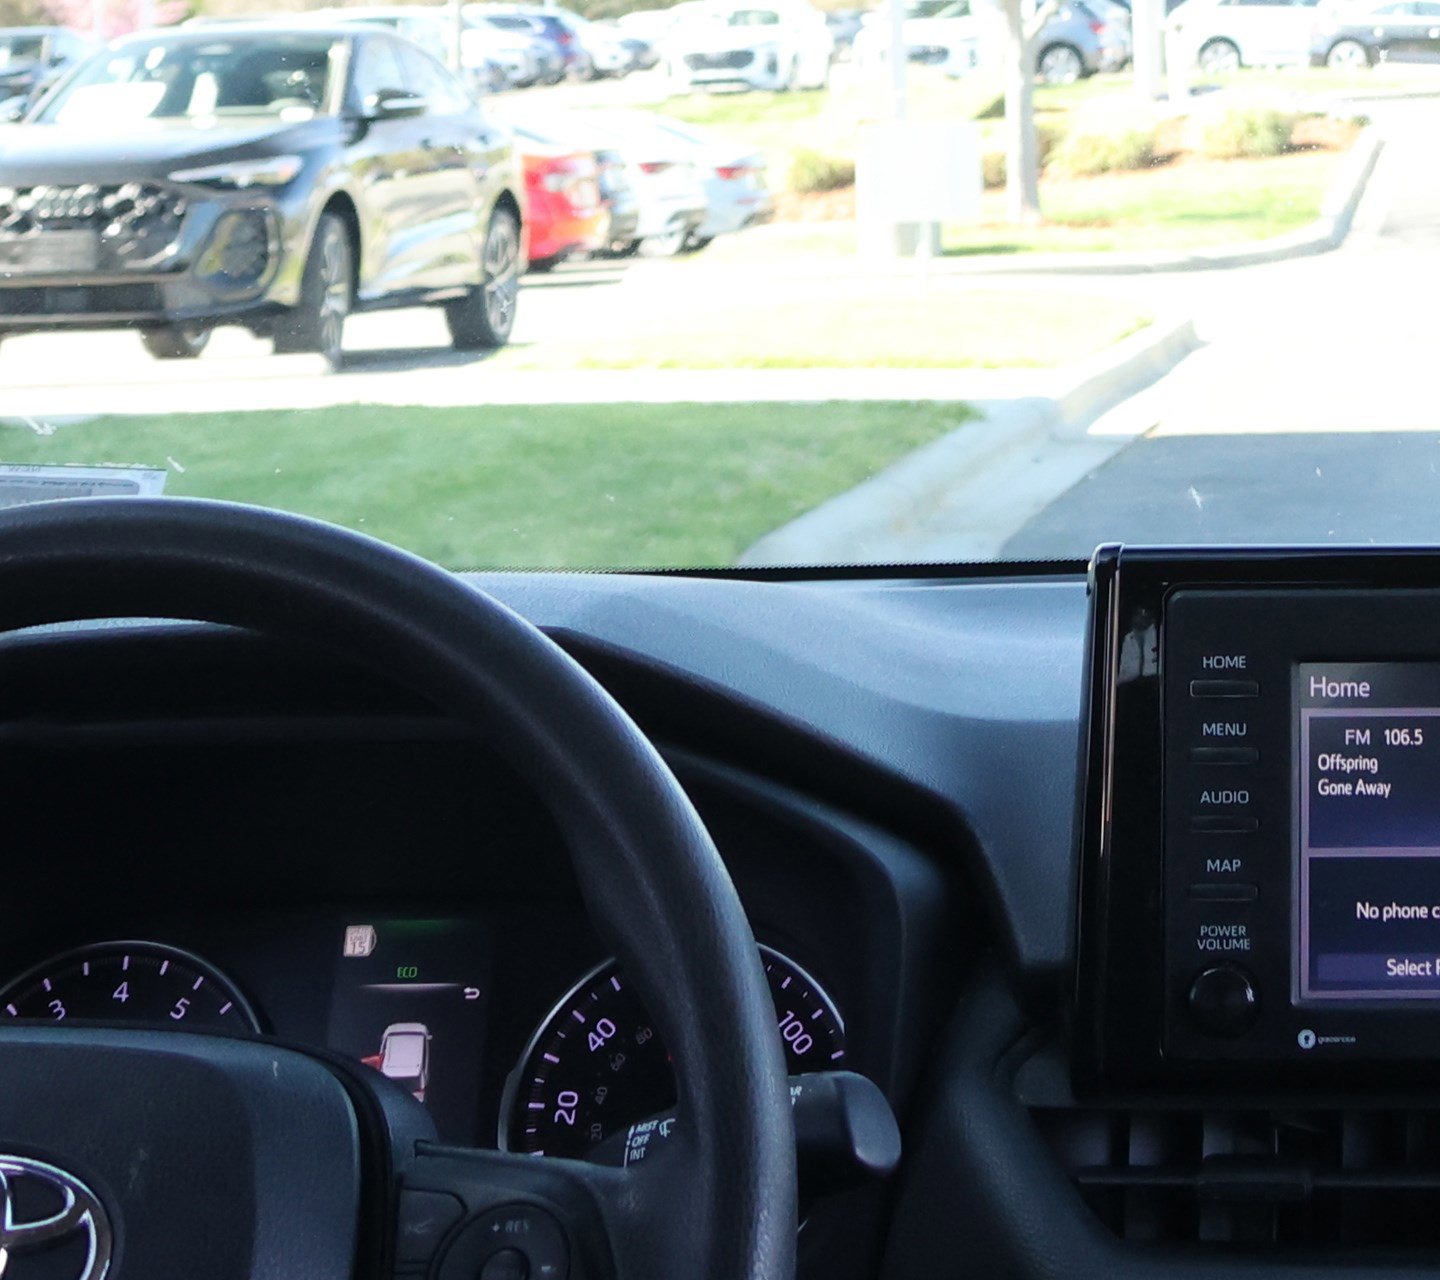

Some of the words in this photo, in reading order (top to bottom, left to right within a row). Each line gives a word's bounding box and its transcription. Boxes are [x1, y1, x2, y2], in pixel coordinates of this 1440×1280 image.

[1203, 655, 1247, 669] HOME
[1310, 675, 1371, 699] Home
[1202, 722, 1247, 737] MENU
[1345, 729, 1371, 745] FM
[1384, 728, 1424, 745] 106.5
[1318, 753, 1379, 774] Offspring
[1200, 790, 1250, 804] AUDIO
[1318, 778, 1353, 796] Gone
[1355, 778, 1391, 799] Away
[1206, 858, 1242, 873] MAP
[1356, 901, 1380, 920] No
[1382, 902, 1429, 922] phone
[1200, 924, 1247, 937] POWER
[1196, 938, 1251, 951] VOLUME
[396, 965, 419, 979] ECO
[1386, 958, 1432, 977] Select
[112, 980, 130, 1003] 4
[47, 998, 67, 1021] 3
[169, 998, 191, 1021] 5
[586, 1017, 617, 1052] 40
[777, 1010, 814, 1056] 100
[553, 1090, 579, 1125] 20
[635, 1119, 659, 1134] MIST
[631, 1133, 651, 1148] OFF
[629, 1146, 647, 1161] INT
